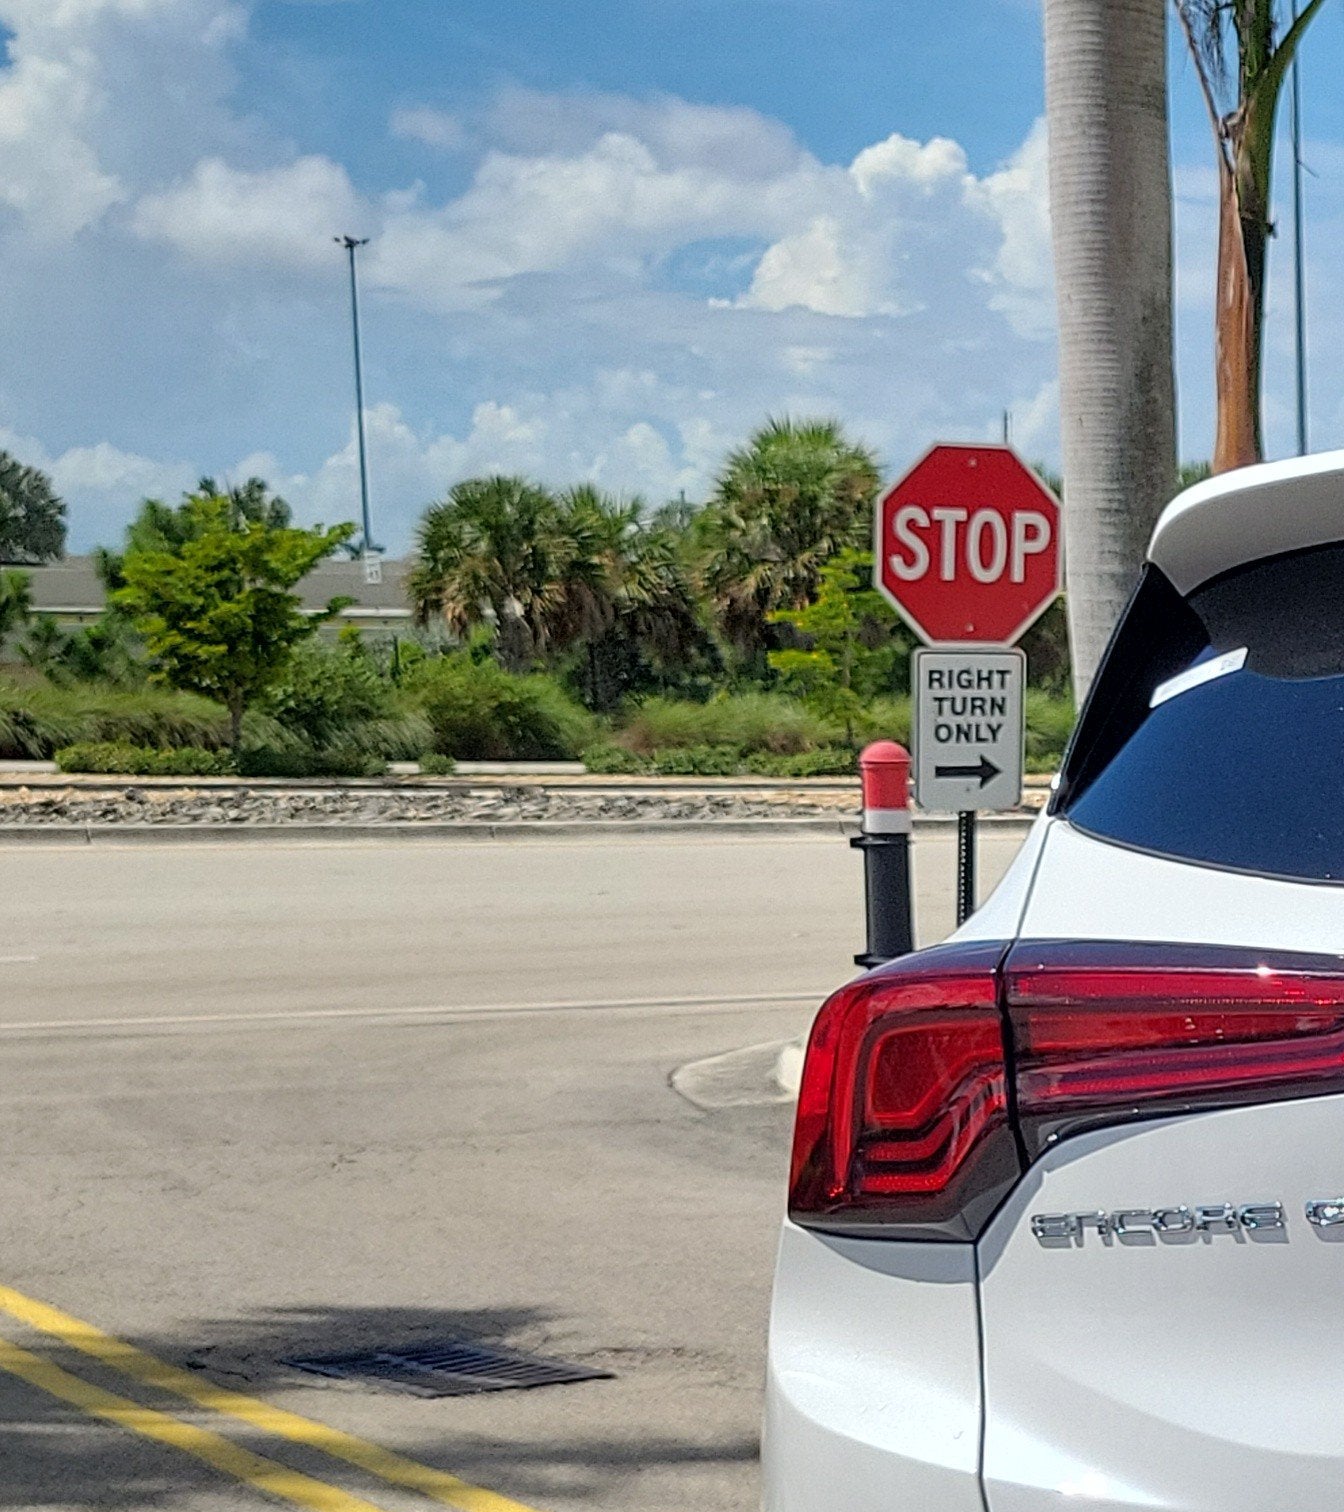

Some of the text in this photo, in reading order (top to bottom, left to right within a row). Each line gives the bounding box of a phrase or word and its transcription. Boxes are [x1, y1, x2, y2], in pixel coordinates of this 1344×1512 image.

[888, 505, 1052, 584] STOP
[928, 669, 1012, 691] RIGHT
[932, 696, 1006, 717] TURN
[934, 722, 1003, 744] ONLY
[1031, 1202, 1284, 1238] ENCORE
